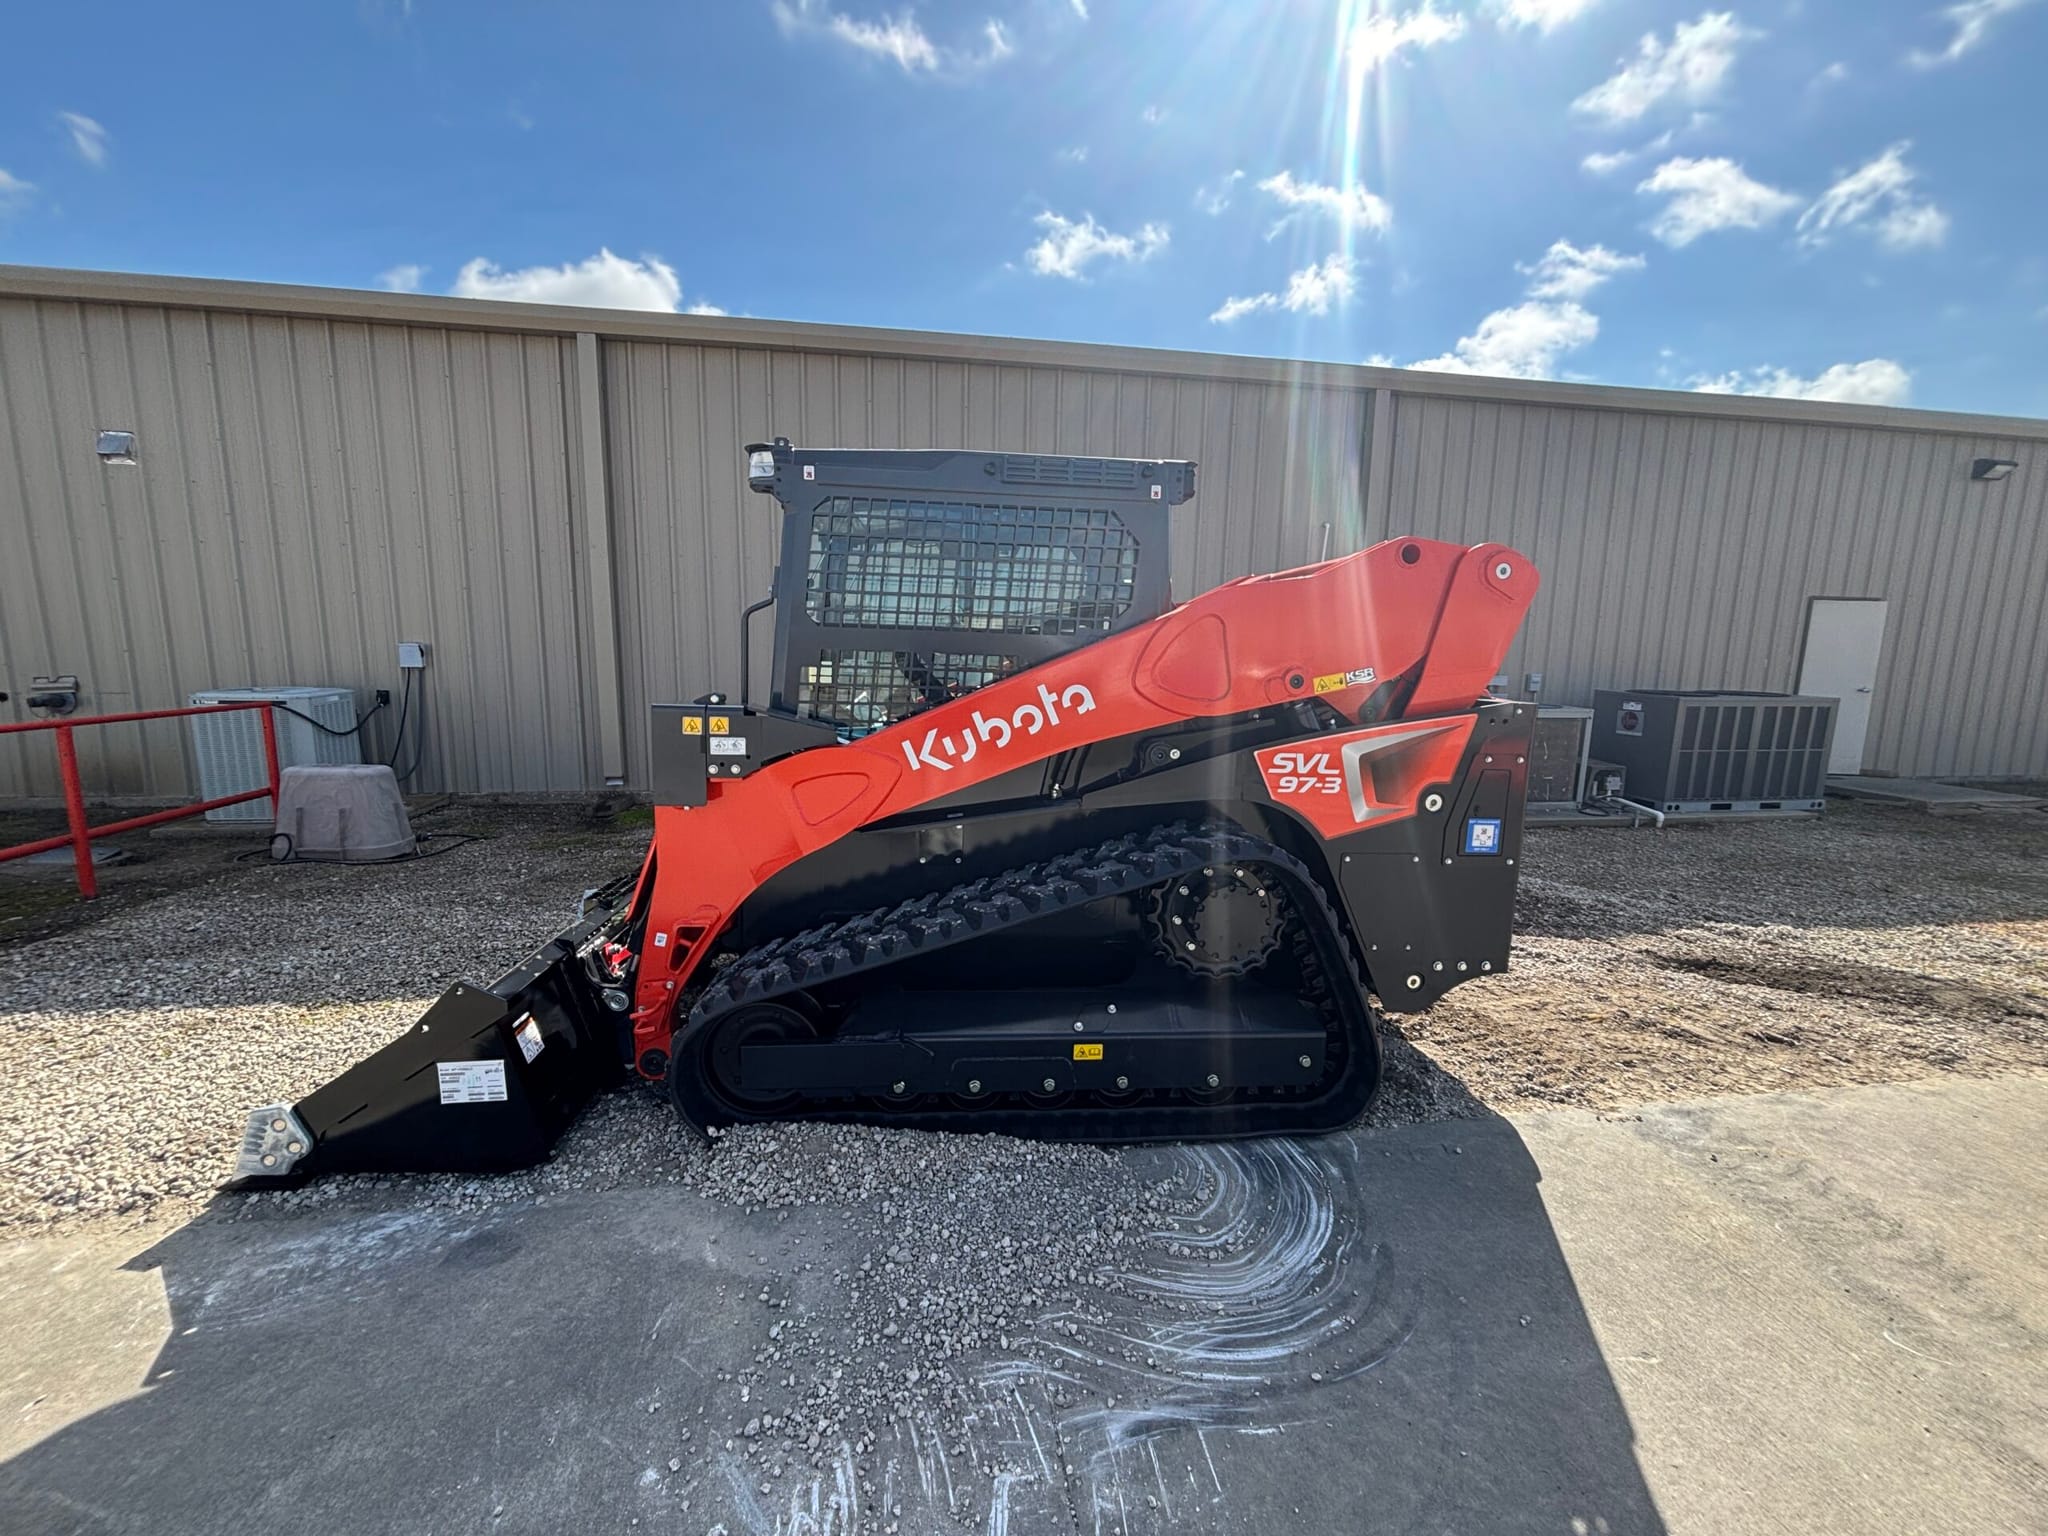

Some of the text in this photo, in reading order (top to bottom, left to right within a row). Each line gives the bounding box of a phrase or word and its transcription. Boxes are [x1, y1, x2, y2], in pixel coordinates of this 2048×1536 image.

[1346, 667, 1375, 683] KSR
[901, 683, 1097, 771] Kubota
[1267, 752, 1340, 775] SVL
[1277, 776, 1342, 794] 97-3
